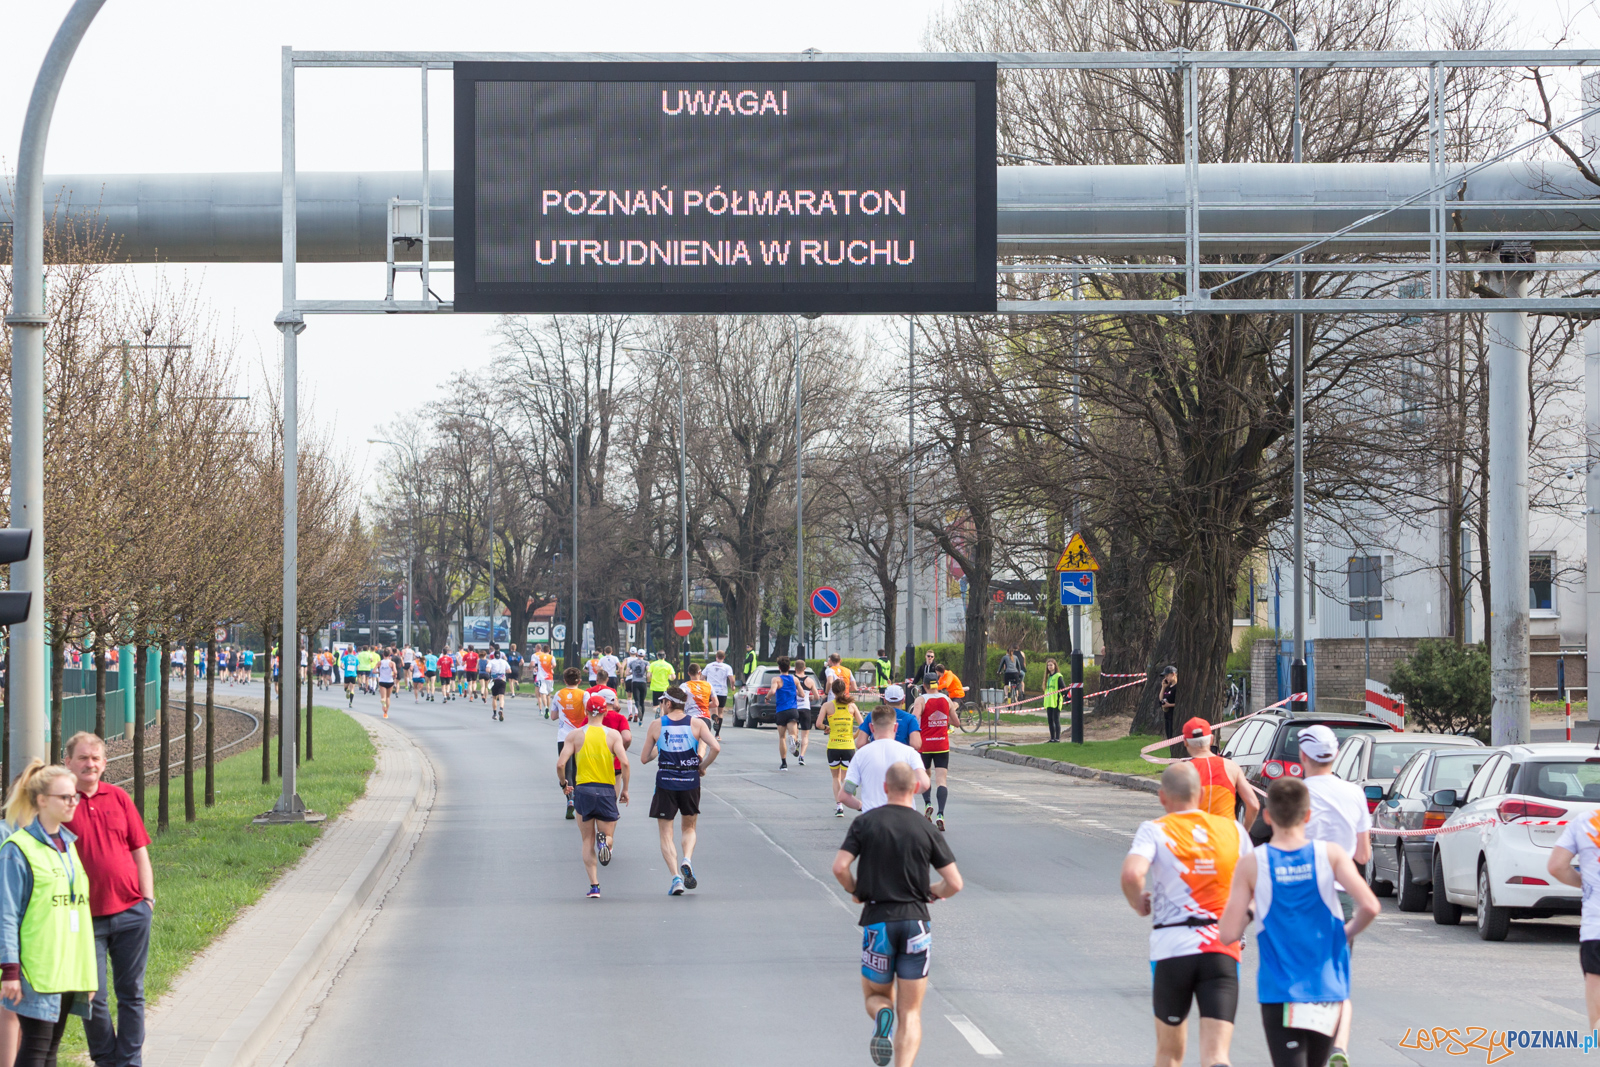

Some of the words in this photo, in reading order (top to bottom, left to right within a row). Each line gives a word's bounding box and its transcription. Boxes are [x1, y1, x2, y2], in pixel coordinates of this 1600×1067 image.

[661, 90, 788, 116] UWAGA!
[542, 185, 673, 215] POZNAŃ
[684, 185, 906, 215] PÓŁMARATON
[535, 240, 752, 266] UTRUDNIENIA
[759, 240, 791, 266] W
[800, 240, 915, 266] RUCHU
